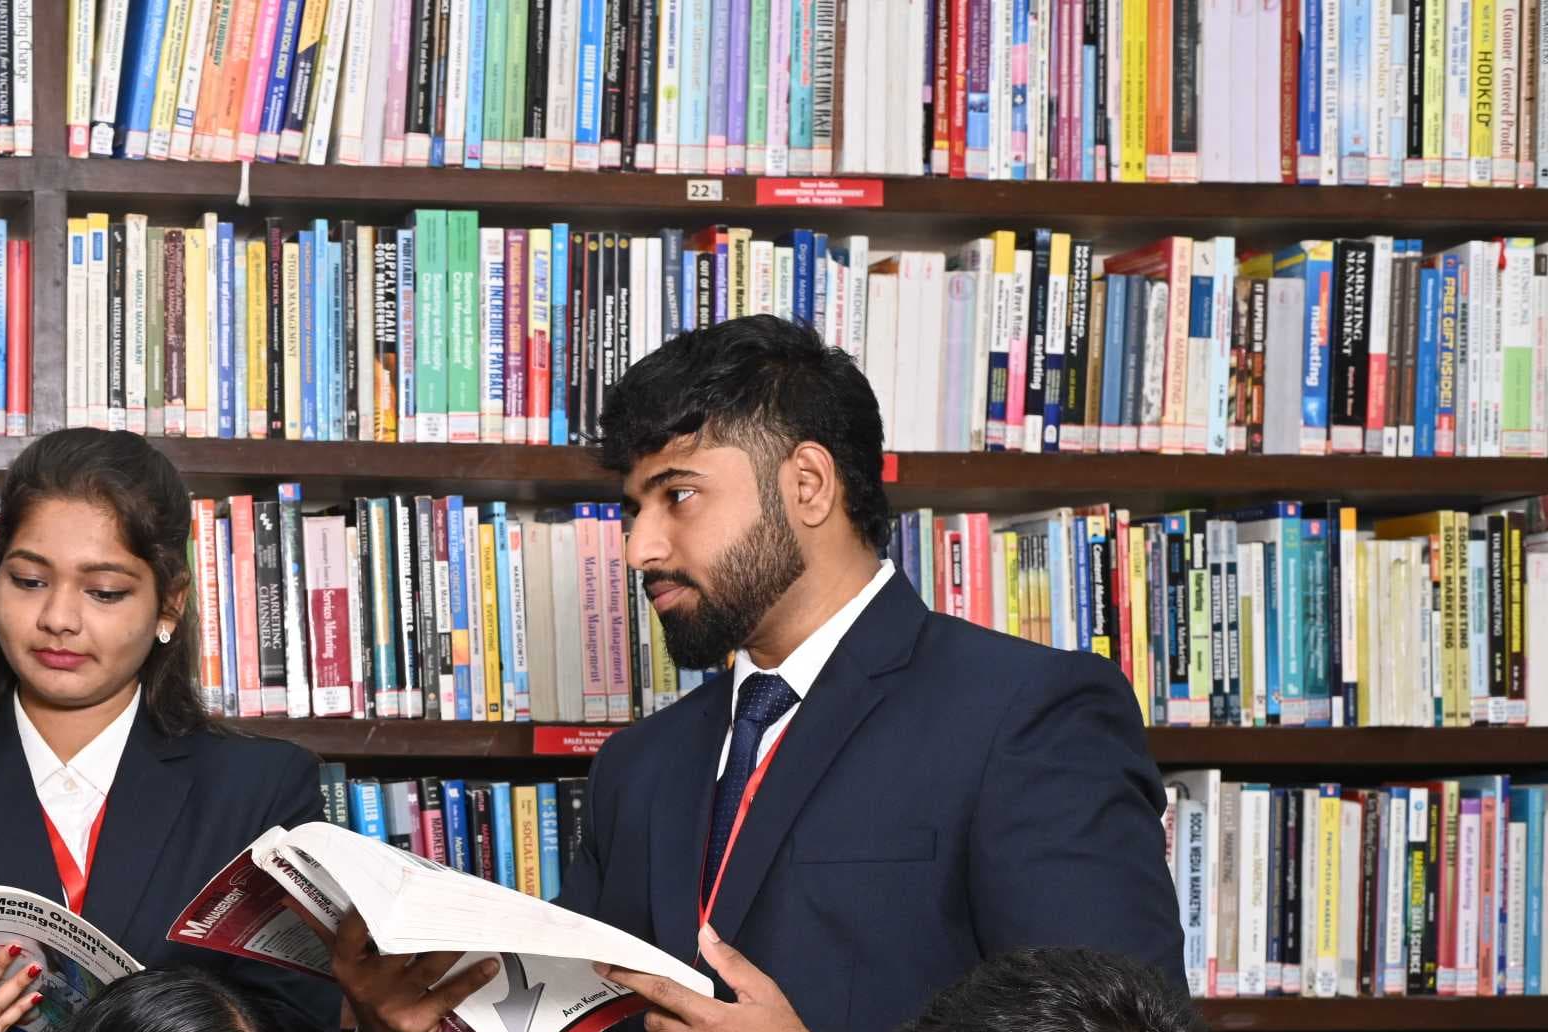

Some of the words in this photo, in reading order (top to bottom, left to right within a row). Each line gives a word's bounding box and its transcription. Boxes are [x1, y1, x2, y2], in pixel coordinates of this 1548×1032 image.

[144, 18, 159, 77] Methodology
[937, 29, 947, 64] Methods
[1326, 46, 1337, 63] THE
[814, 30, 834, 106] GENERATION
[937, 67, 947, 77] for
[1326, 67, 1337, 93] WIDE
[1378, 42, 1389, 98] Products
[1476, 51, 1493, 125] HOOKED
[937, 80, 947, 113] Business
[1326, 97, 1337, 120] LENS
[814, 110, 834, 138] R&D
[385, 243, 396, 293] SUPPLY
[453, 272, 462, 296] Chain
[489, 262, 503, 280] THE
[1012, 286, 1024, 312] Wave
[1342, 250, 1355, 356] MANAGEMENT
[1353, 251, 1366, 340] MARKETING
[1444, 277, 1456, 313] FREE
[385, 302, 396, 343] CHAIN
[451, 298, 462, 363] Management
[489, 286, 503, 347] INCREDIBLE
[1012, 317, 1024, 341] Rider
[1442, 317, 1454, 349] GIFT
[1031, 335, 1043, 390] marketing
[1306, 306, 1321, 386] marketing
[489, 353, 503, 400] PAYBACK
[1440, 352, 1453, 407] INSIDE!!
[1093, 544, 1104, 581] Content
[1459, 526, 1468, 570] SOCIAL
[585, 556, 598, 610] Marketing
[609, 558, 622, 612] Marketing
[1194, 573, 1205, 612] Marketing
[260, 586, 271, 649] CHANNELS
[270, 584, 281, 649] MARKETING
[324, 591, 335, 619] Services
[1094, 584, 1106, 635] Marketing
[1459, 576, 1468, 649] MARKETING
[323, 621, 337, 658] Marketing
[586, 614, 601, 682] Management
[610, 616, 625, 685] Management
[334, 783, 345, 822] KOTLER
[522, 821, 533, 863] SOCIAL
[1188, 812, 1202, 844] SOCIAL
[1188, 847, 1202, 873] MEDIA
[179, 888, 246, 938] MANAGEMENT
[1188, 876, 1202, 927] MARKETING
[1410, 908, 1423, 932] DATA
[1410, 933, 1423, 974] SCIENCE
[562, 998, 584, 1018] Arun
[581, 990, 608, 1009] Kumar
